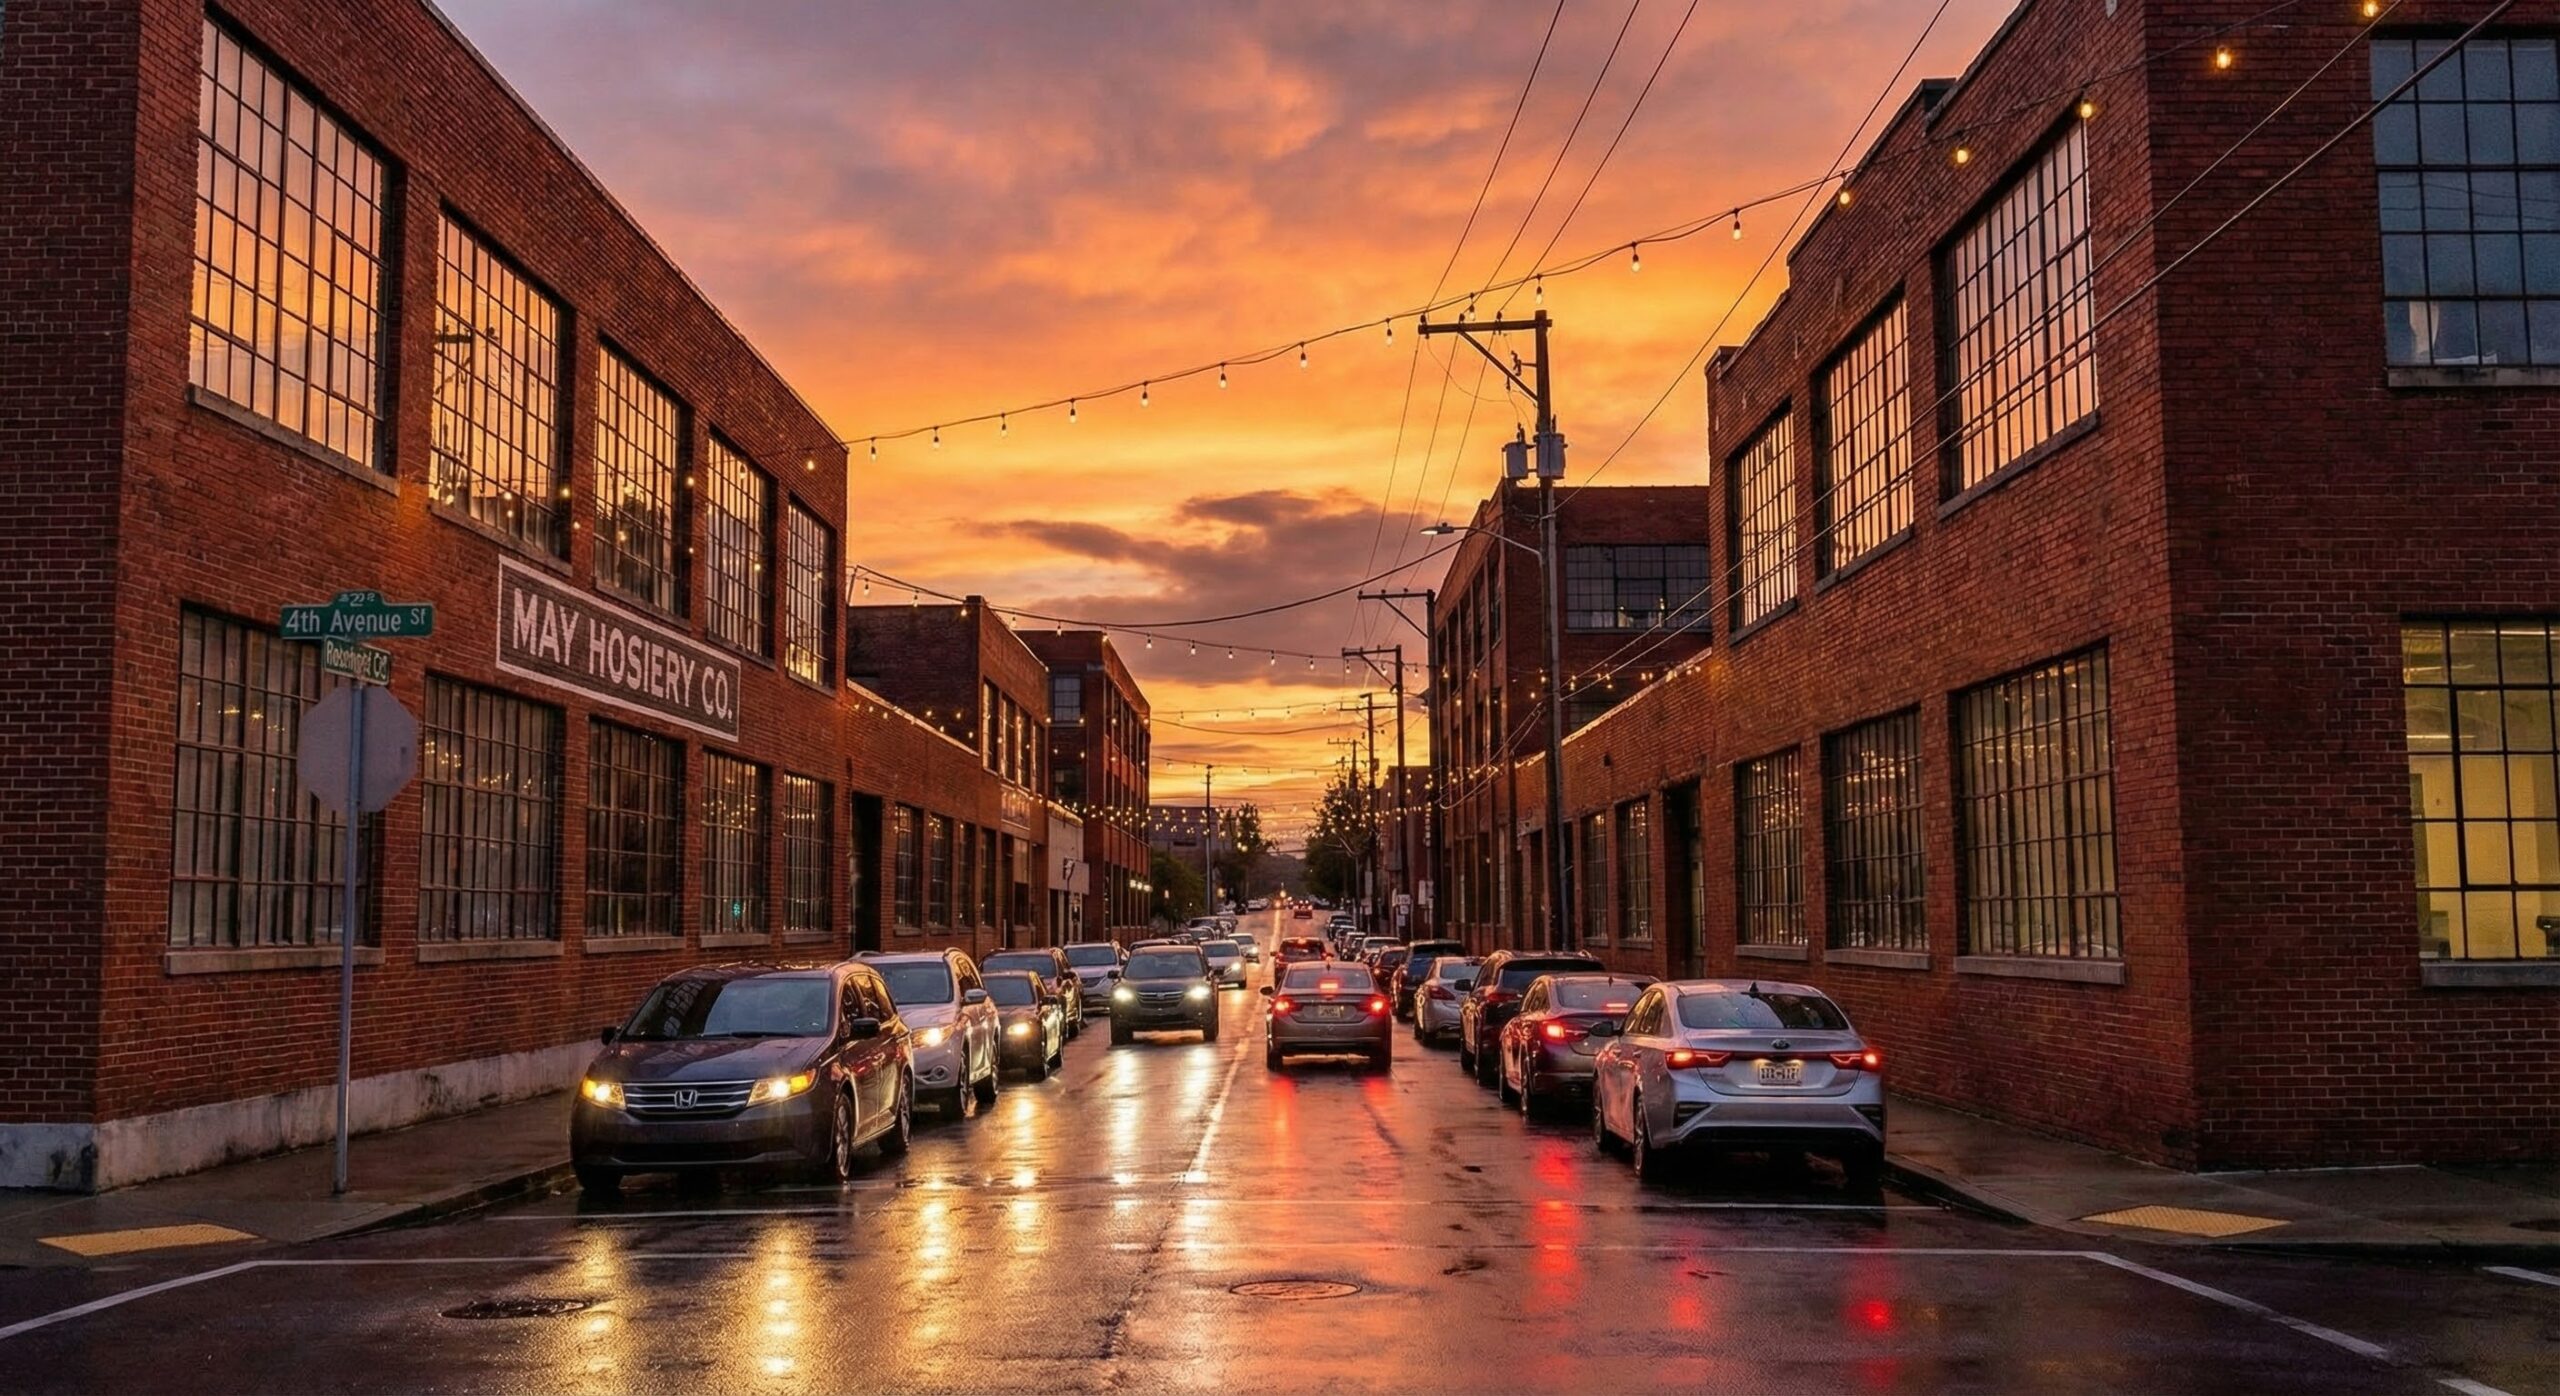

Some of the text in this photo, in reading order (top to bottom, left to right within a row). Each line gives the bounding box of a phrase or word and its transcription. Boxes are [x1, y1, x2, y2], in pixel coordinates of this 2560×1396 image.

[286, 609, 320, 633] 4th
[329, 608, 402, 633] Avenue
[512, 587, 733, 723] MAY HOSIERY CO.
